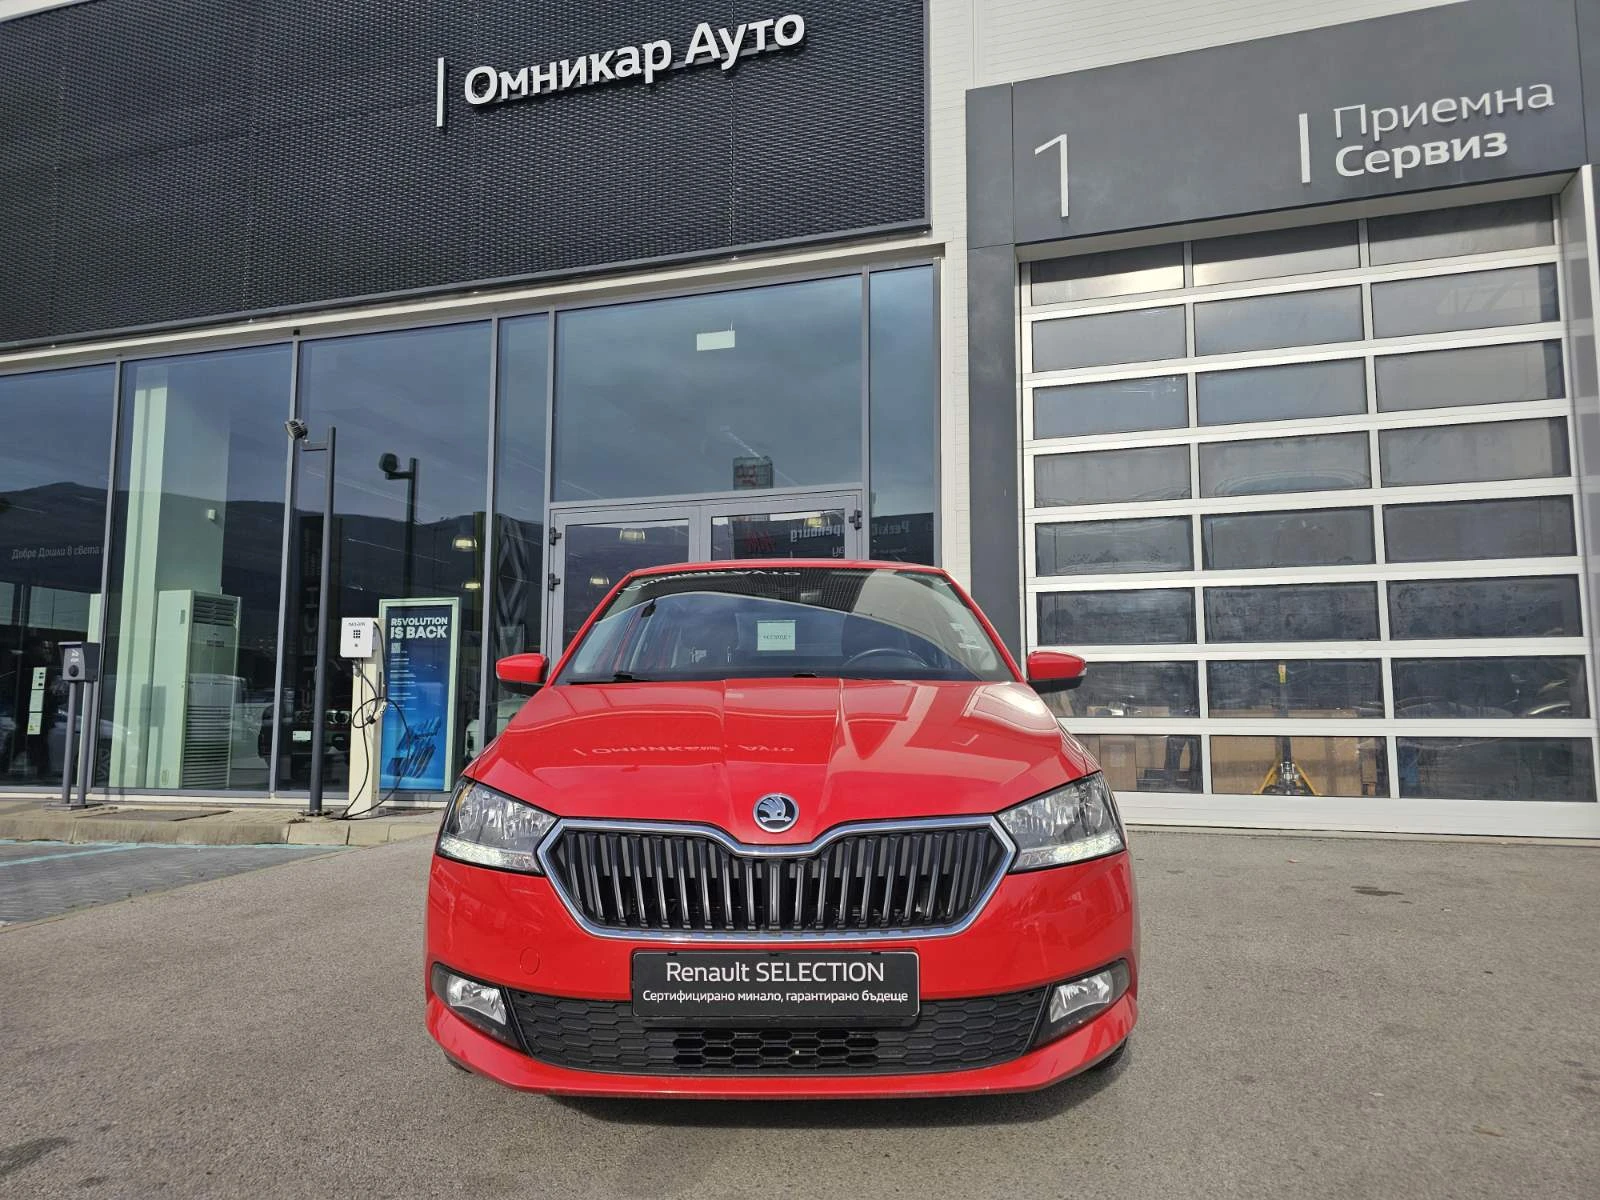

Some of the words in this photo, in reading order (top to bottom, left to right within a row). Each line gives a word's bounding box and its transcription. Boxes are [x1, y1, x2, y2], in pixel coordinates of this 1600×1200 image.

[464, 38, 672, 106] Омникар
[684, 13, 805, 71] Ауто
[1333, 82, 1555, 142] Приемна
[1335, 130, 1508, 180] Сервиз
[1034, 133, 1069, 218] 1
[390, 617, 448, 627] R5VOLUTION
[390, 626, 404, 639] IS
[406, 626, 448, 639] BACK
[666, 961, 750, 982] Renault
[756, 962, 885, 982] SELECTION
[642, 989, 735, 1003] Сертифицирано
[738, 991, 783, 1003] минало,
[786, 991, 859, 1003] гарантирано
[862, 989, 909, 1003] бъдеще
